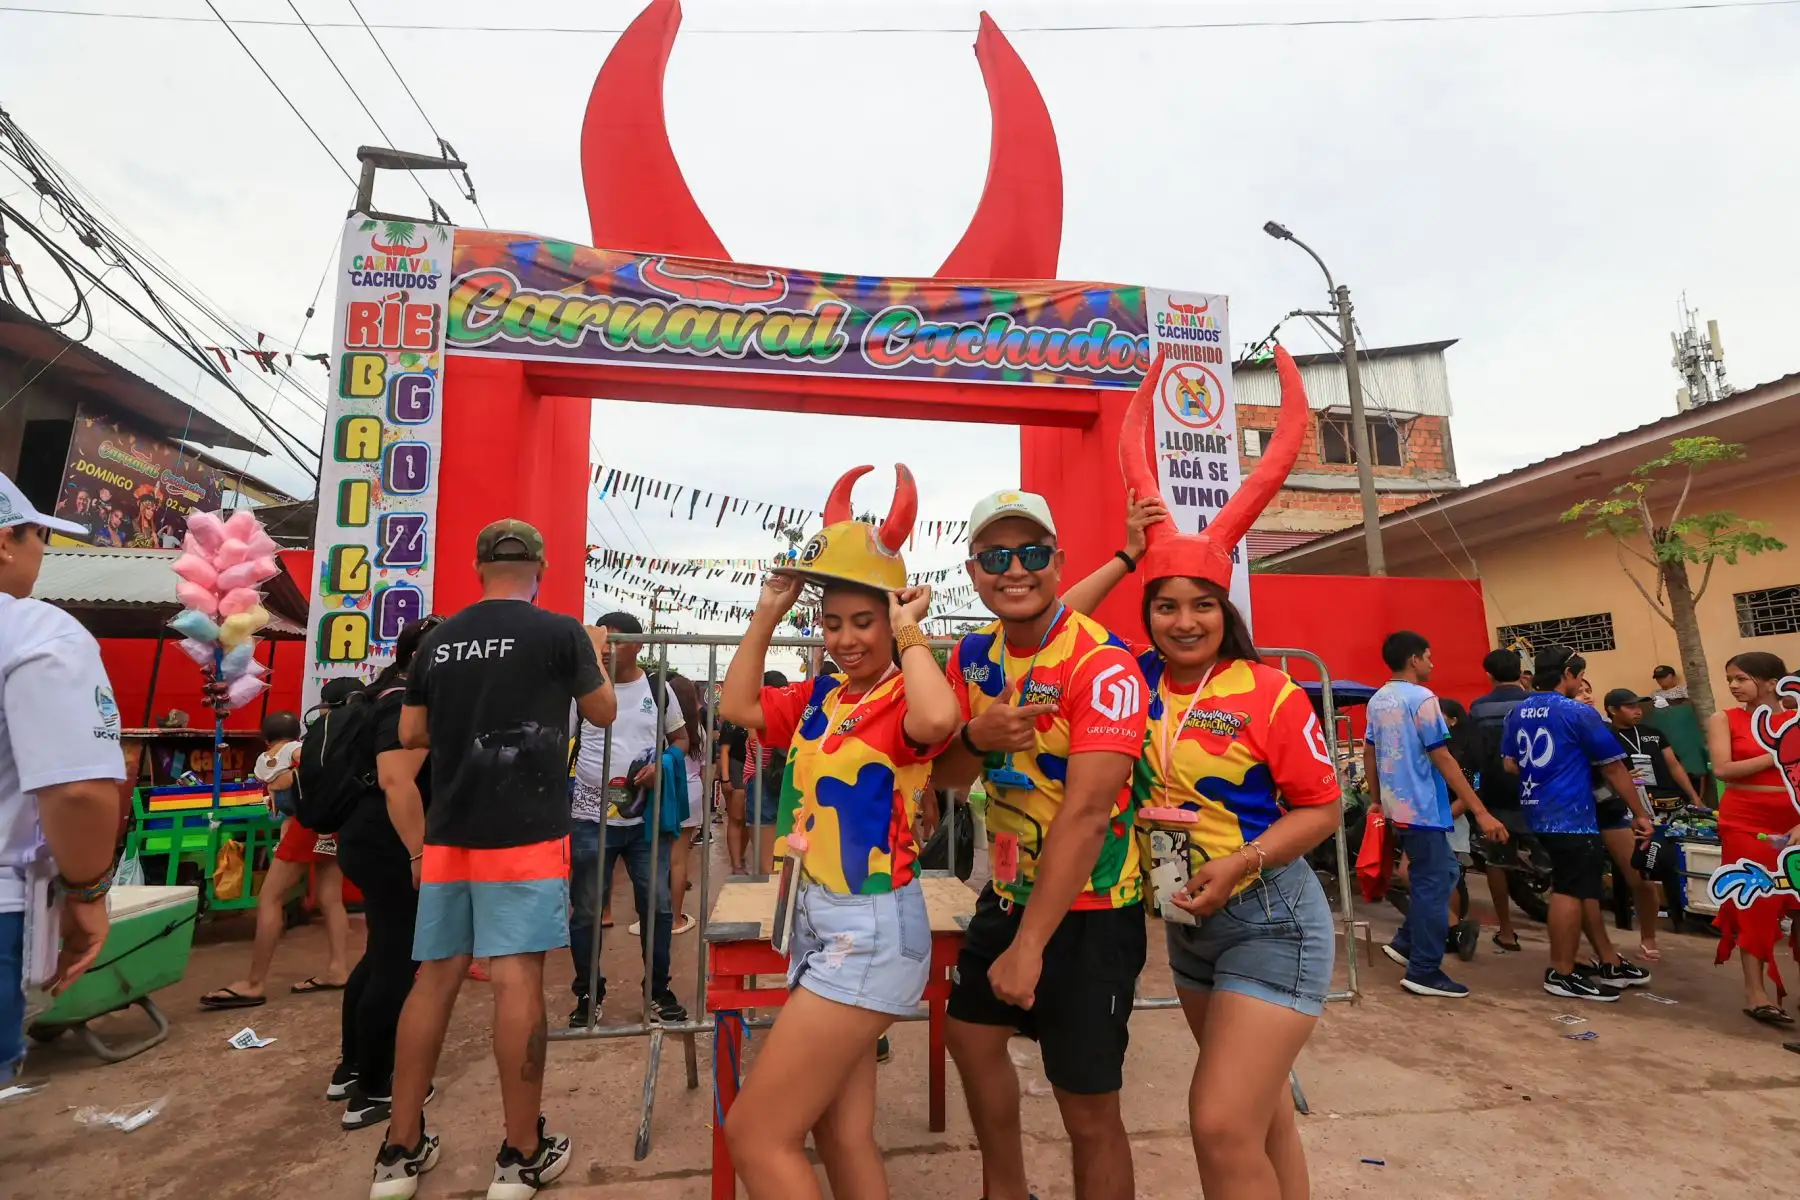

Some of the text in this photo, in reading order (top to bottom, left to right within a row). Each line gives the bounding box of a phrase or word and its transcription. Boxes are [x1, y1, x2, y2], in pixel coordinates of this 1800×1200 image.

[353, 255, 440, 273] CARNAVAL
[348, 269, 442, 289] CACHUDOS
[344, 291, 441, 353] RÍE
[445, 268, 851, 364] Carnaval
[1157, 311, 1221, 329] CARNAVAL
[1155, 324, 1221, 342] CACHUDOS
[1157, 342, 1223, 364] PROHIBIDO
[1165, 431, 1227, 454] LLORAR
[76, 459, 134, 491] DOMINGO
[1169, 457, 1229, 482] ACÁ SE
[166, 497, 178, 510] 02
[1172, 486, 1229, 509] VINO
[434, 638, 515, 663] STAFF
[1520, 706, 1550, 719] ERICK
[1086, 726, 1137, 738] GRUPO TAO
[1516, 727, 1555, 768] 90
